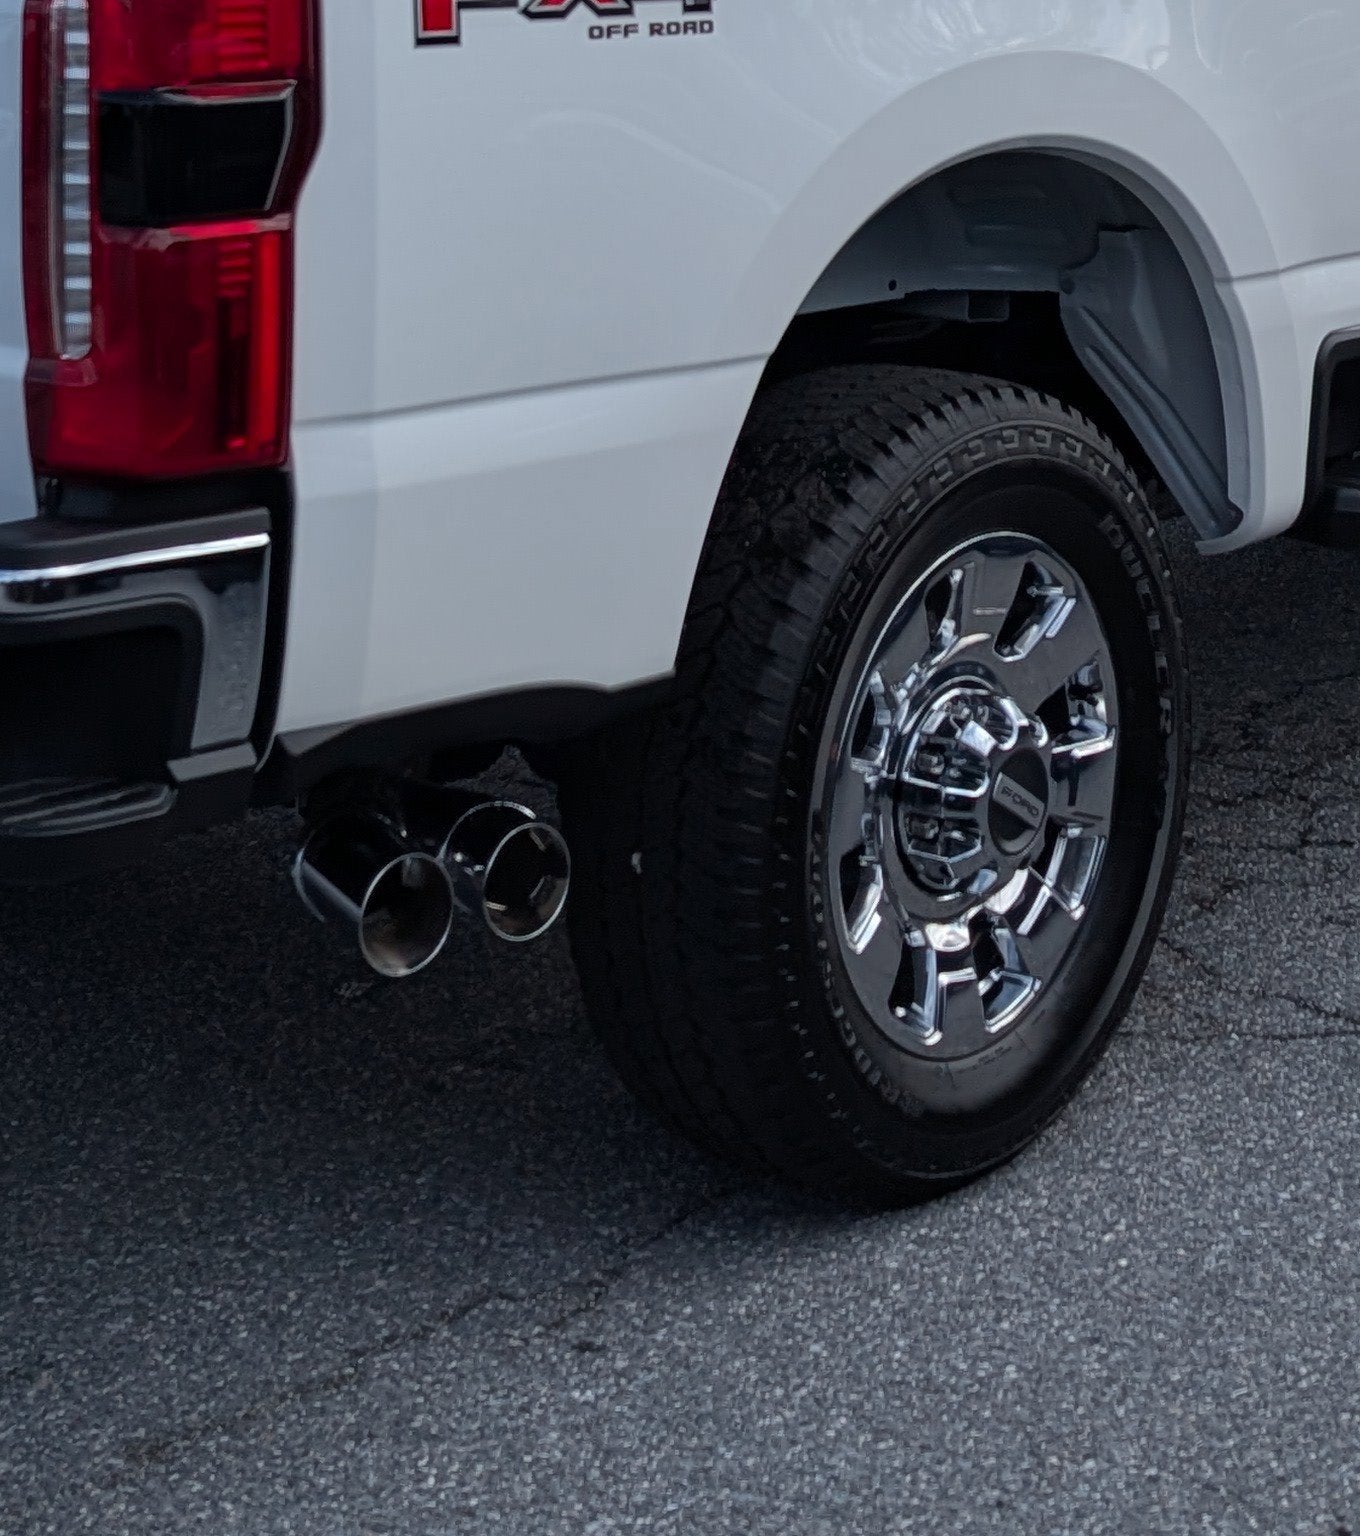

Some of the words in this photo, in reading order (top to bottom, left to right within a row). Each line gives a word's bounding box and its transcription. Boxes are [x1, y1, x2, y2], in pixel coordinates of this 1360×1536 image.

[588, 23, 640, 41] OFF
[649, 19, 715, 37] ROAD
[1001, 785, 1039, 819] FORD
